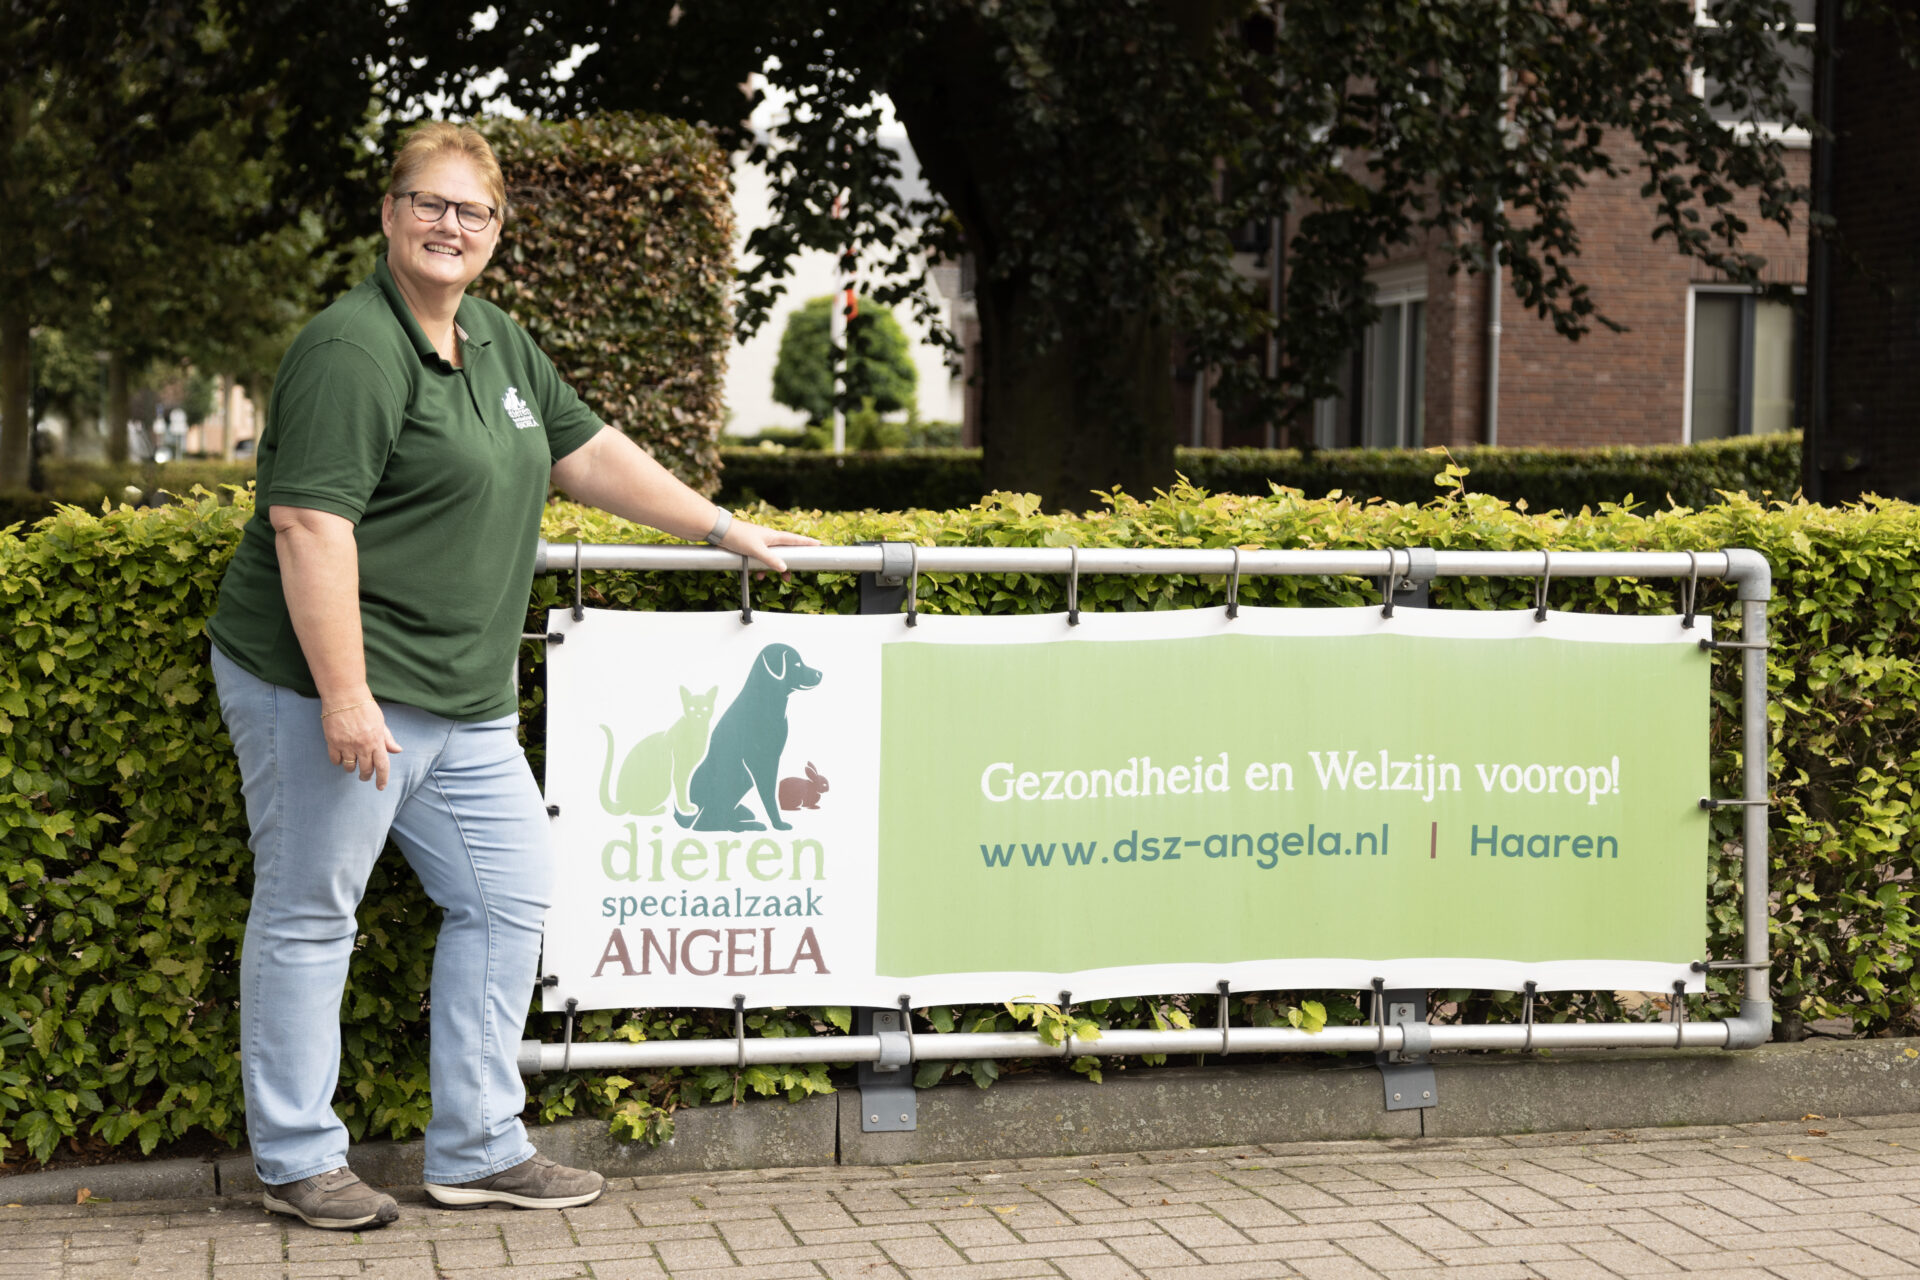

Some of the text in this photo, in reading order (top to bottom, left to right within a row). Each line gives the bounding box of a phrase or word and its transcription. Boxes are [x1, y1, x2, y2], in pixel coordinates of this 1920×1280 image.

[980, 749, 1620, 806] Gezondheid en Welzijn voorop!
[601, 821, 827, 882] dieren
[980, 823, 1618, 870] www.dsz-angela.nl Haaren
[602, 887, 823, 925] speciaalzaak
[591, 926, 831, 977] ANGELA
